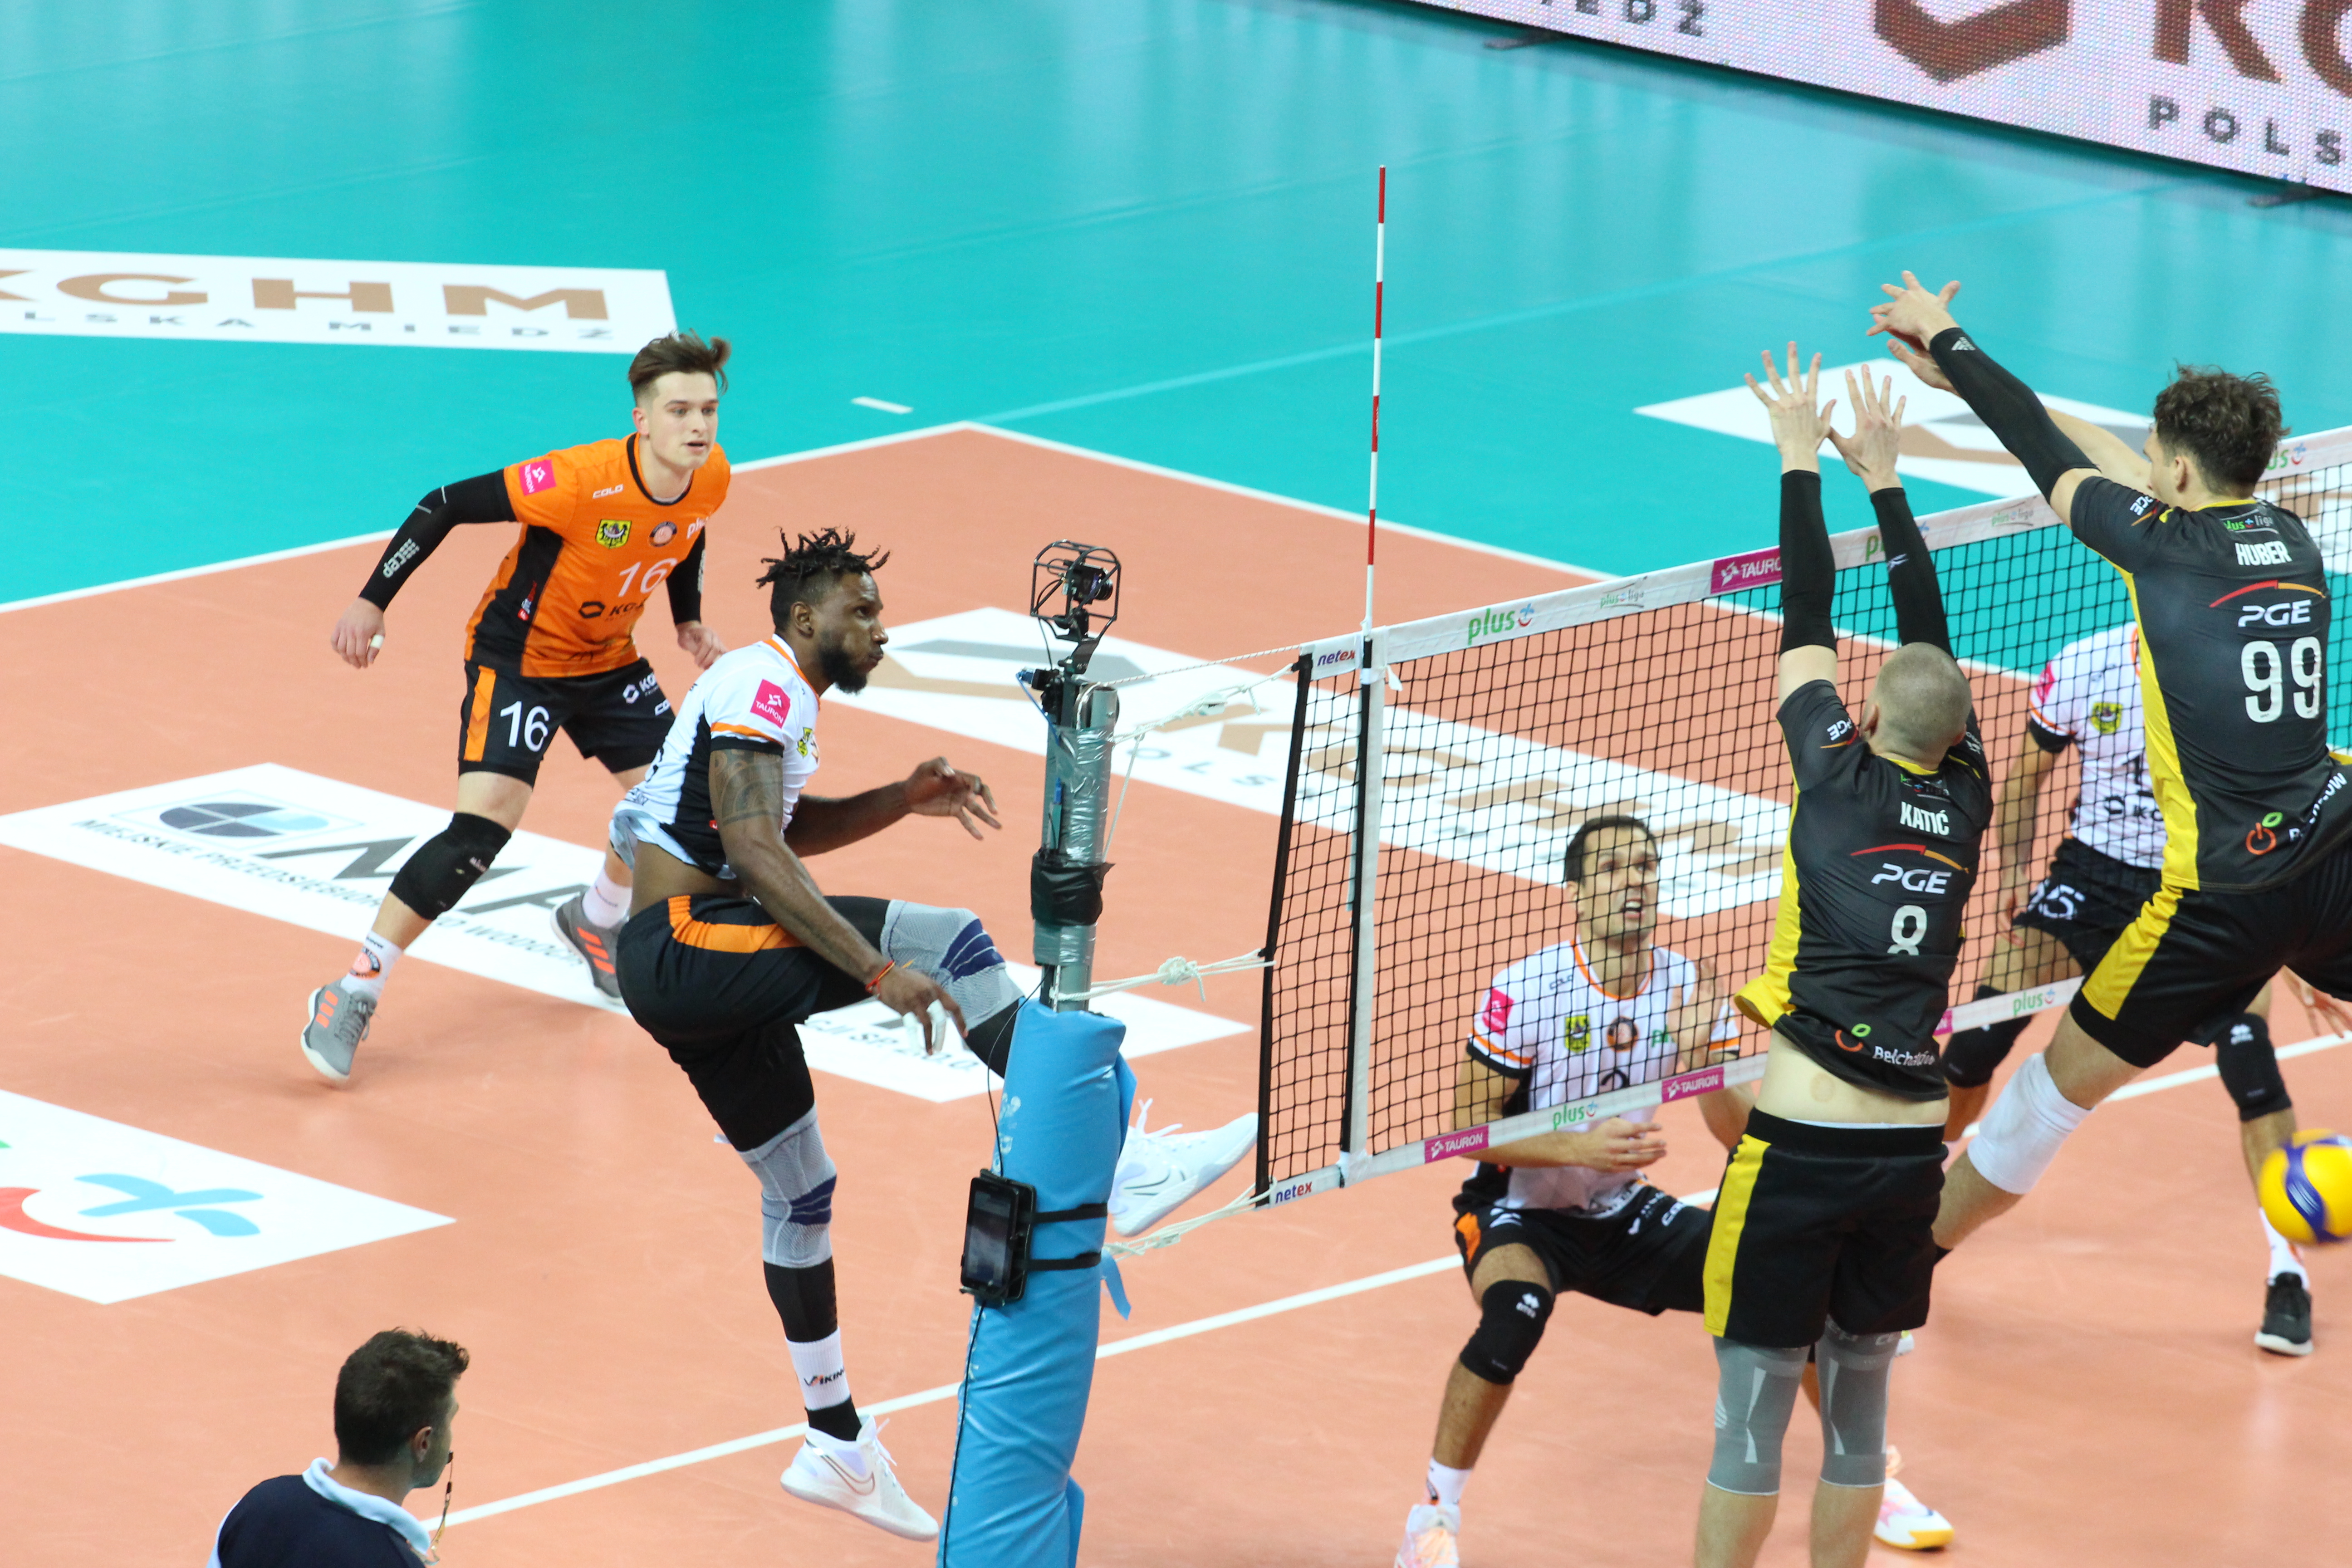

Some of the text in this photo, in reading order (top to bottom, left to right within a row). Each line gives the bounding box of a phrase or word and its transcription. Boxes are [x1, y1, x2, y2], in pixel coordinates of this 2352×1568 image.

[2235, 540, 2293, 566] HUBER
[618, 557, 677, 597] 16
[1741, 556, 1782, 579] TAURO
[2238, 599, 2312, 627] PGE
[1468, 608, 1515, 646] plus
[1317, 650, 1356, 666] netex
[2241, 636, 2322, 723] 99
[755, 700, 784, 724] TAURON
[500, 700, 550, 752] 16
[1900, 801, 1950, 836] KATIĆ
[1871, 863, 1952, 895] PGE
[2013, 991, 2043, 1017] plus
[1681, 1074, 1719, 1093] TAURON
[1553, 1104, 1585, 1130] plus
[1445, 1133, 1483, 1152] TAURON
[1275, 1181, 1312, 1204] netex
